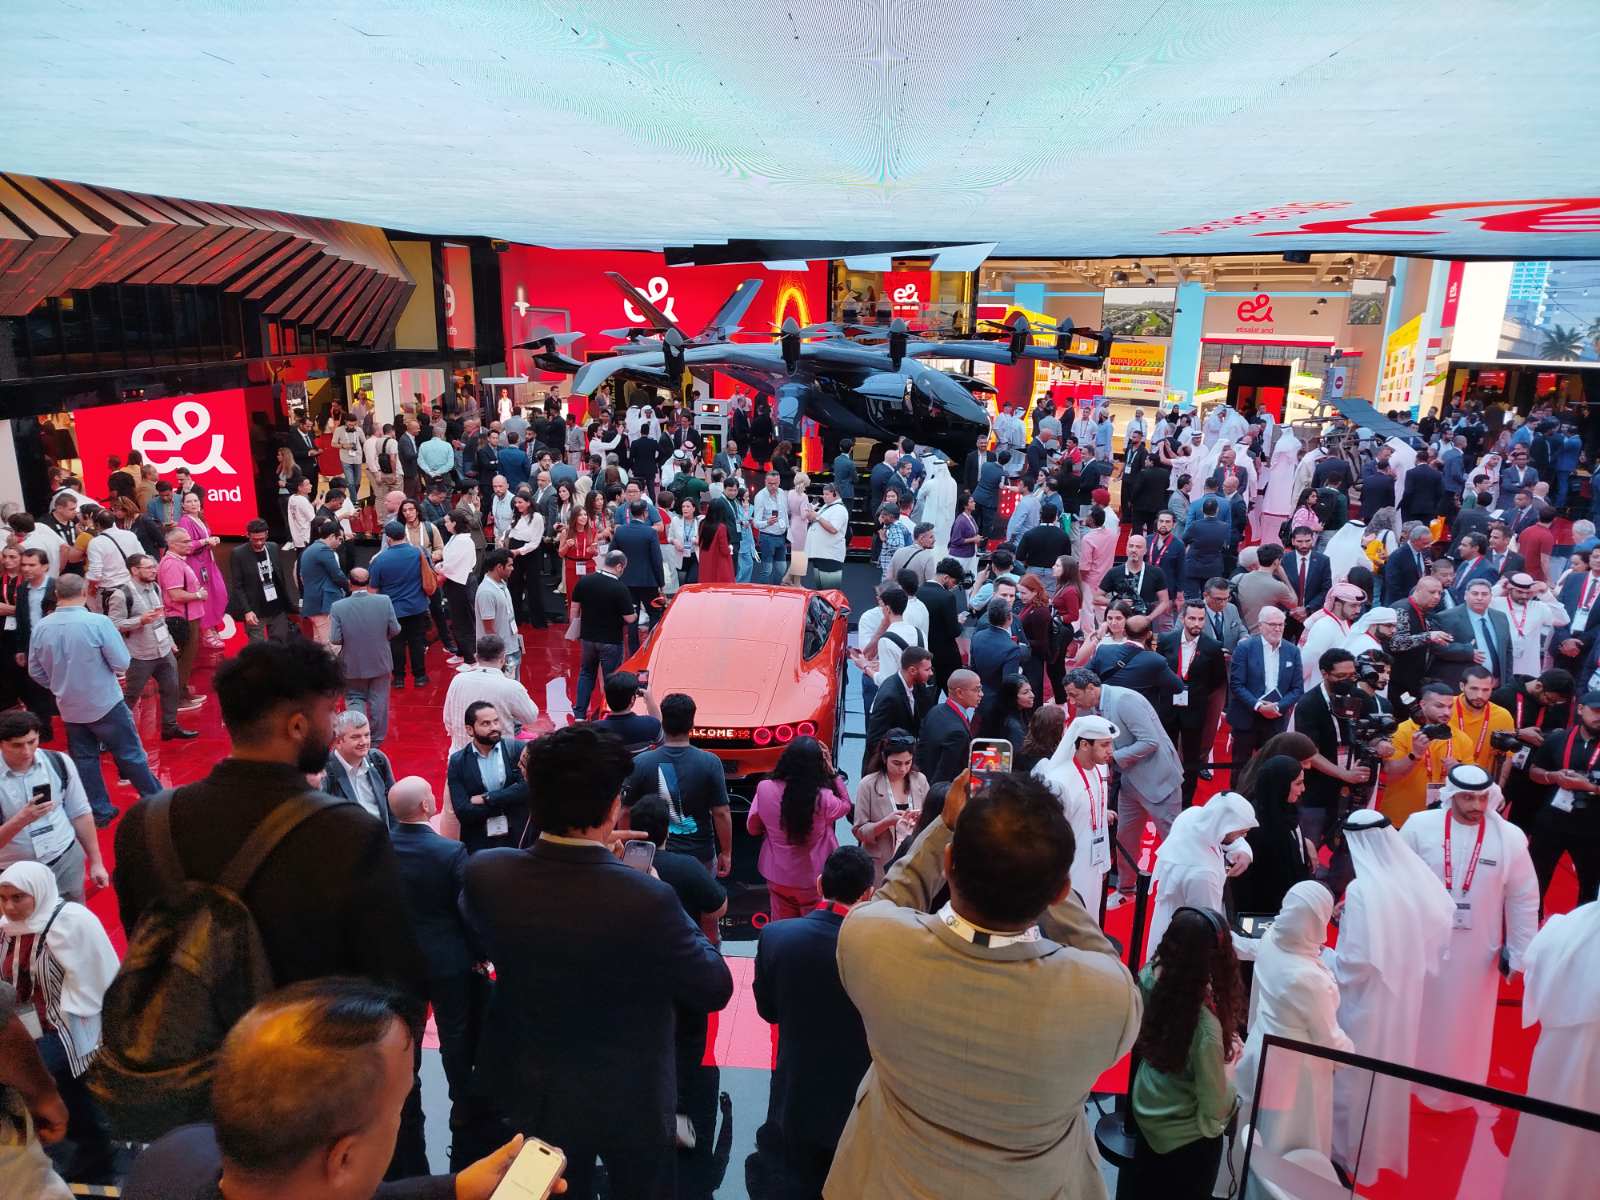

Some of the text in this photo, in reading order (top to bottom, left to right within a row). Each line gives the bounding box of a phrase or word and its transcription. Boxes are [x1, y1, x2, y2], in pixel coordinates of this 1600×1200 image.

[893, 283, 920, 303] e&
[1237, 294, 1274, 322] e&
[130, 401, 238, 475] e&
[207, 485, 242, 502] and
[690, 728, 734, 738] LCOME
